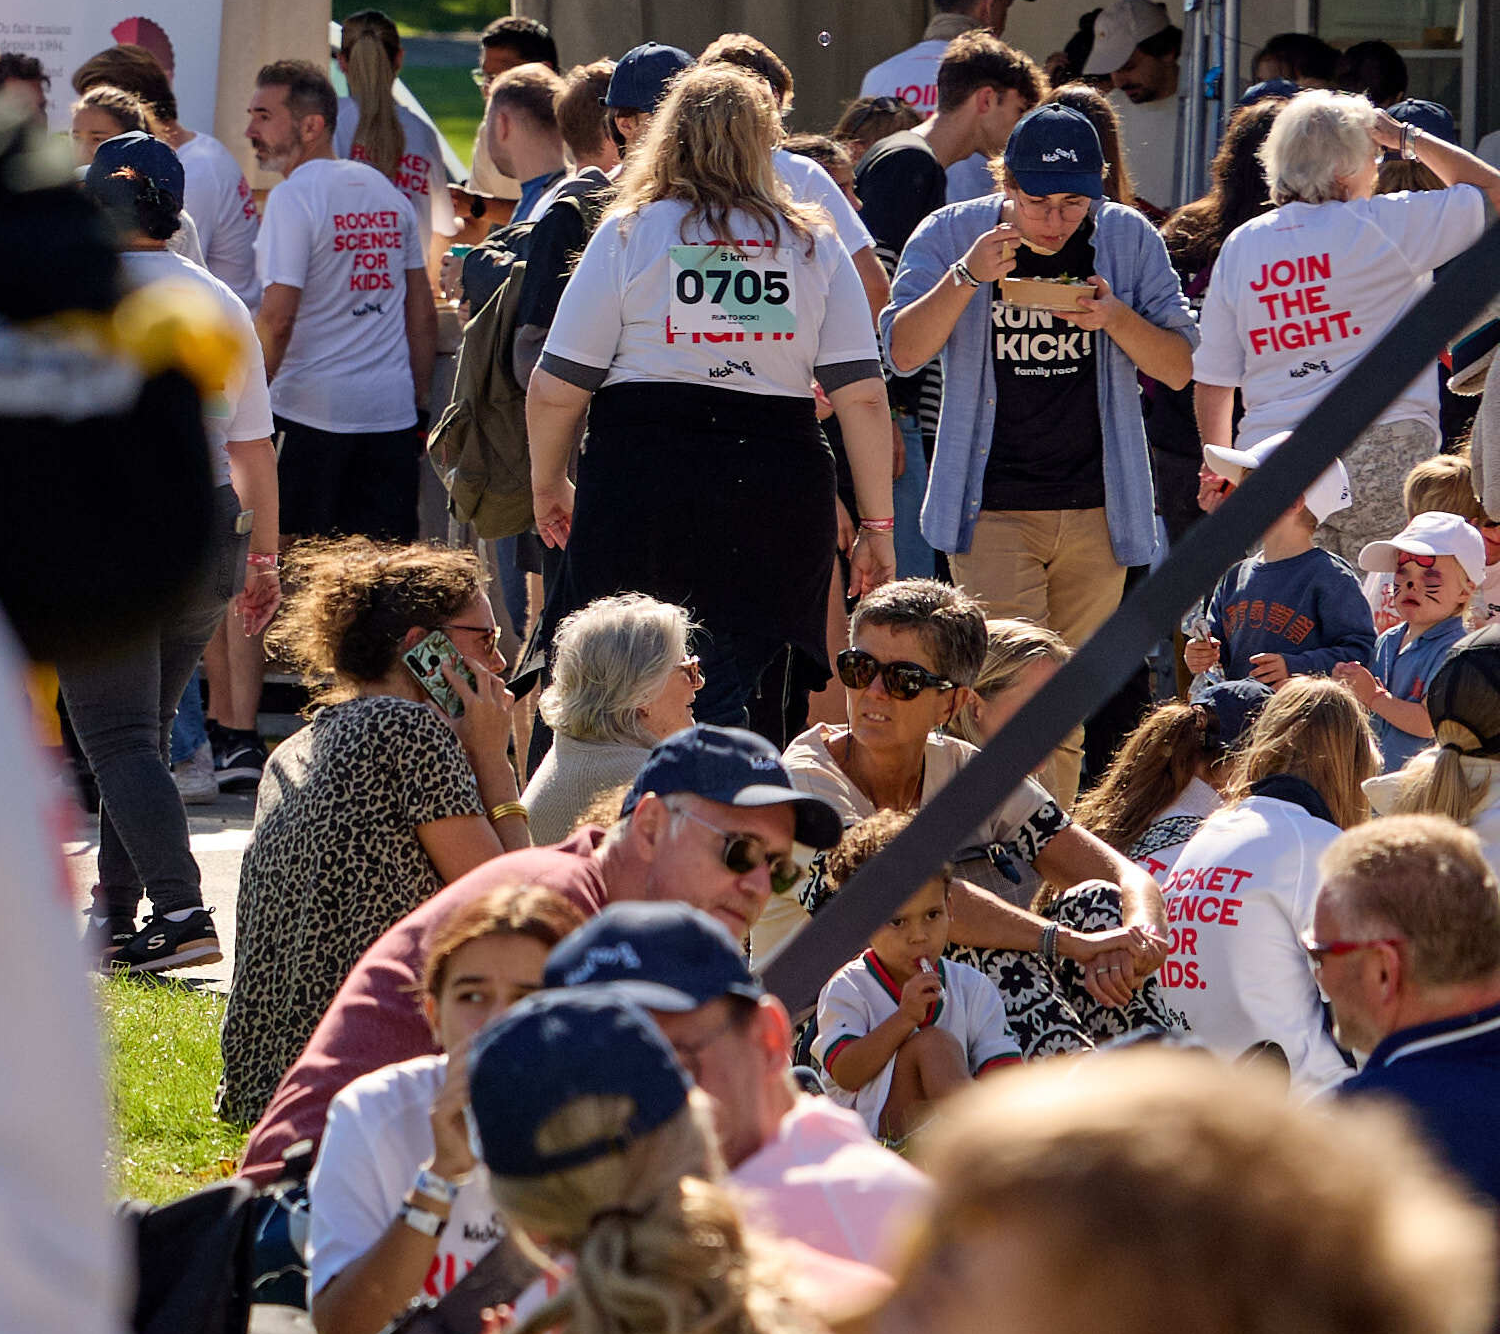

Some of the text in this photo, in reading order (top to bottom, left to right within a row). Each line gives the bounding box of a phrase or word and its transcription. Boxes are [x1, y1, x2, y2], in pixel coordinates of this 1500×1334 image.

[333, 210, 400, 232] ROCKET
[333, 231, 403, 253] SCIENCE
[353, 252, 389, 270] FOR
[720, 252, 749, 262] 5 km
[349, 272, 396, 292] KIDS.
[1249, 252, 1332, 293] JOIN
[676, 269, 791, 305] 0705
[1258, 284, 1332, 321] THE
[1248, 310, 1362, 356] FIGHT.
[996, 331, 1092, 361] KICK!
[709, 366, 734, 378] kick
[1014, 365, 1079, 378] family race
[1159, 960, 1207, 990] IDS.
